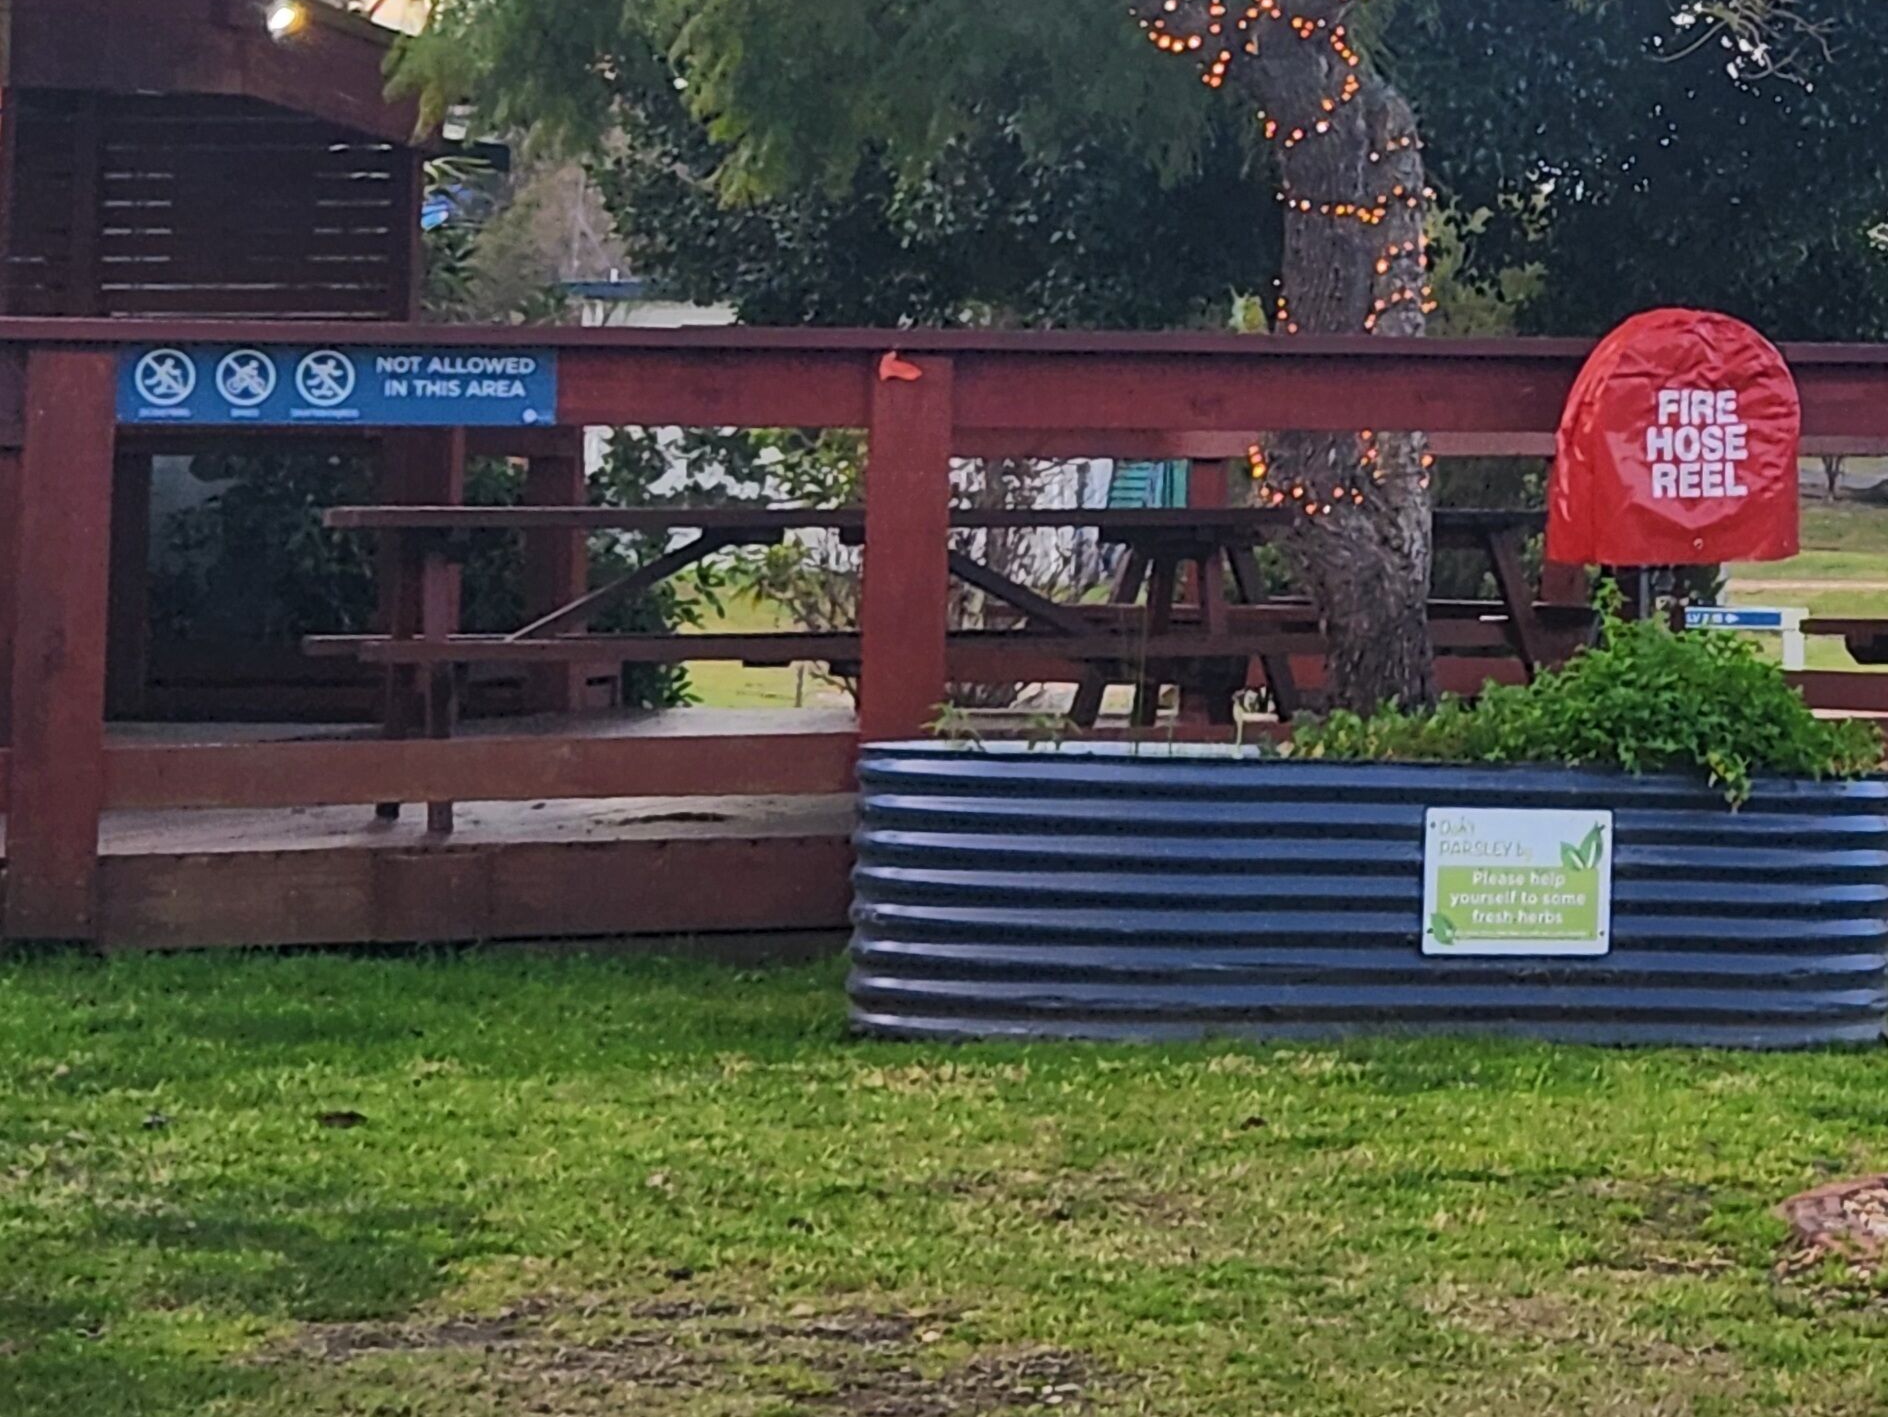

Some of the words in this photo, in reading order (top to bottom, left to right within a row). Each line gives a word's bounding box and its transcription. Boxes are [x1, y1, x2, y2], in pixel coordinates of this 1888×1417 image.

[375, 356, 423, 375] NOT
[426, 356, 537, 375] ALLOWED
[384, 379, 408, 397] IN
[413, 379, 461, 398] THIS
[465, 379, 526, 398] AREA
[1657, 389, 1739, 425] FIRE
[1646, 424, 1748, 462] HOSE
[1651, 462, 1748, 499] REEL
[1439, 841, 1513, 857] PARSLEY
[1472, 870, 1525, 886] Please
[1529, 870, 1566, 888] help
[1450, 889, 1516, 907] yourself
[1520, 891, 1538, 905] to
[1542, 892, 1587, 905] some
[1471, 909, 1513, 925] fresh
[1518, 910, 1563, 925] herbs
